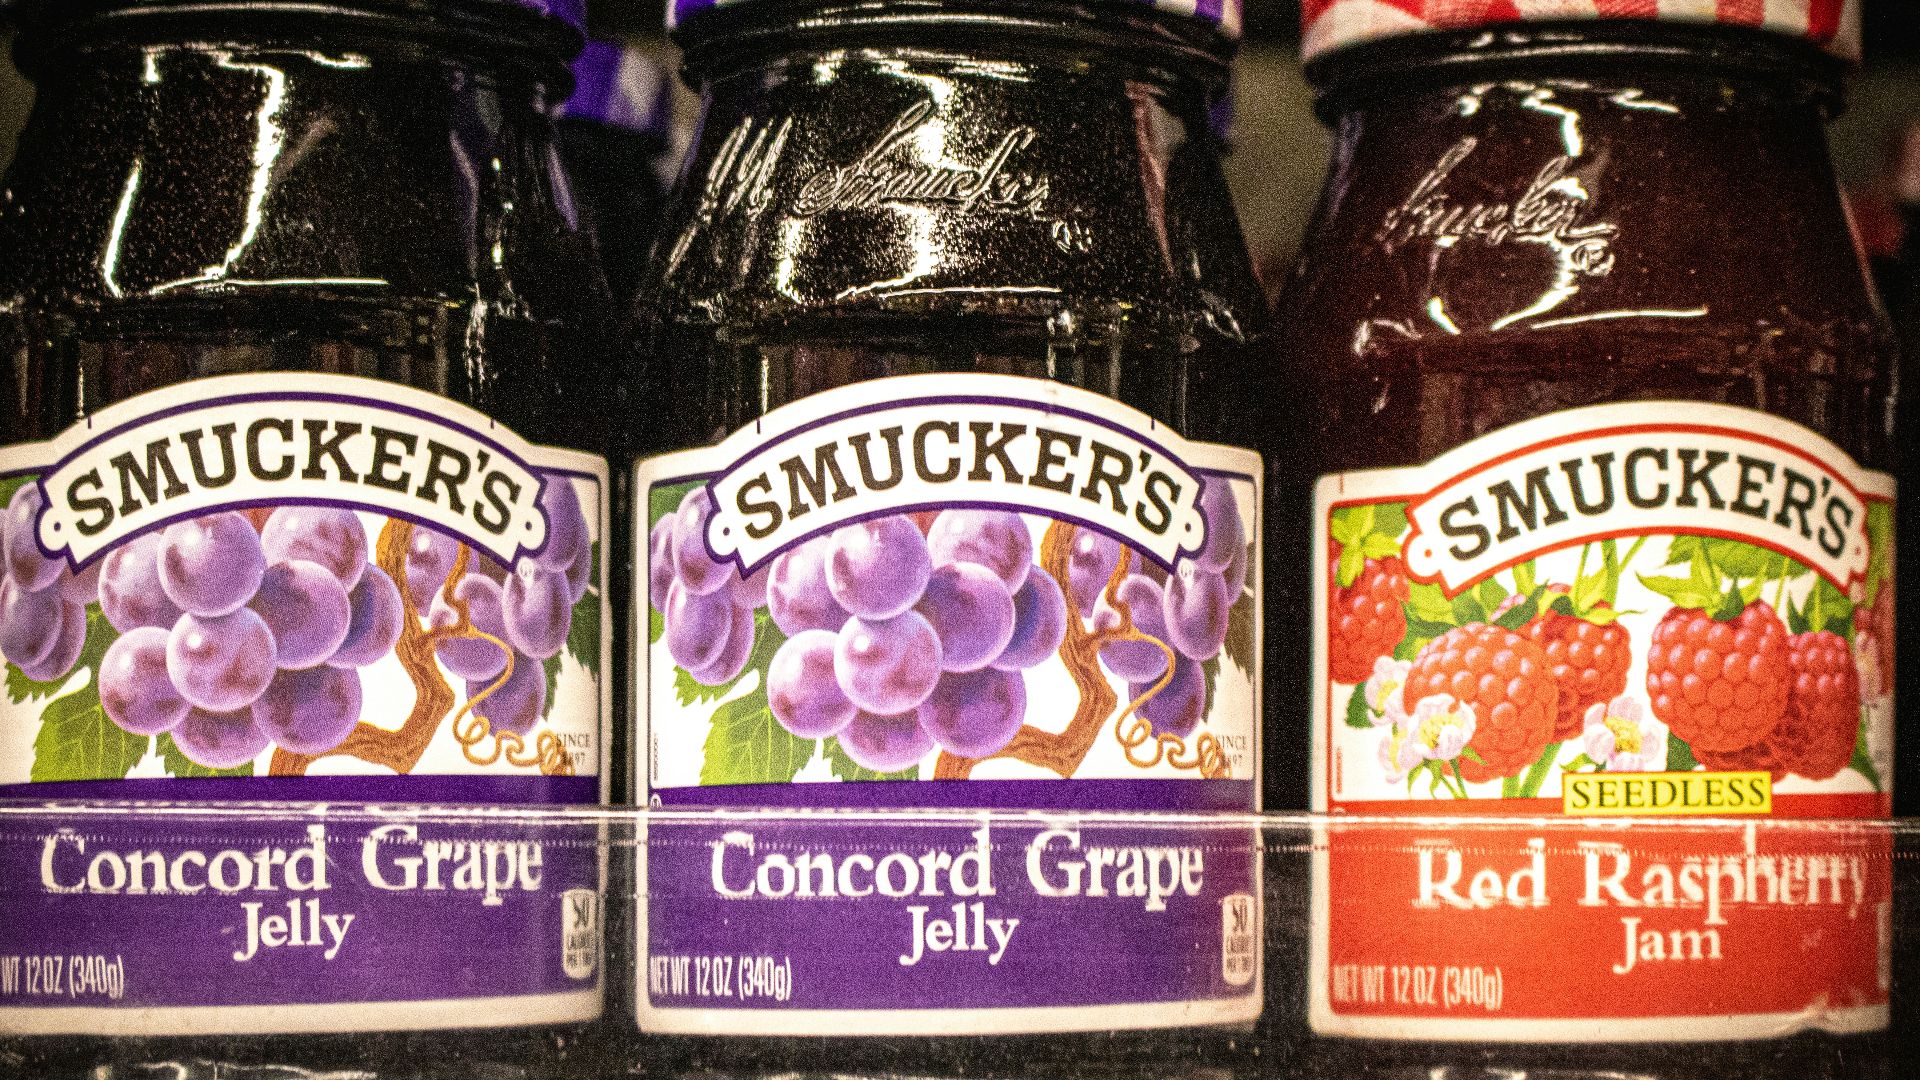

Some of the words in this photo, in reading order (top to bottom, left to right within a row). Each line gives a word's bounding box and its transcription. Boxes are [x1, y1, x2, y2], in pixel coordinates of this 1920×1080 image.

[66, 417, 523, 537] SMUCKER'S
[735, 420, 1182, 539] SMUCKER'S
[1438, 446, 1854, 561] SMUCKER'S
[1571, 776, 1767, 810] SEEDLESS
[40, 825, 332, 895] Concord
[361, 825, 544, 906] Grape
[711, 826, 997, 899] Concord
[1025, 826, 1204, 912] Grape
[1413, 837, 1550, 910] Red
[233, 898, 356, 962] Jelly
[899, 901, 1020, 966] Jelly
[1613, 916, 1723, 975] Jam
[68, 954, 125, 1000] (340g)
[650, 955, 669, 995] NET
[670, 955, 692, 996] WT
[694, 955, 711, 997] 12
[712, 955, 734, 997] OZ
[737, 955, 793, 1001] (340g)
[1360, 965, 1386, 1004] WT
[1391, 965, 1411, 1004] 12
[1413, 965, 1438, 1006] OZ
[1443, 965, 1504, 1012] (340g)
